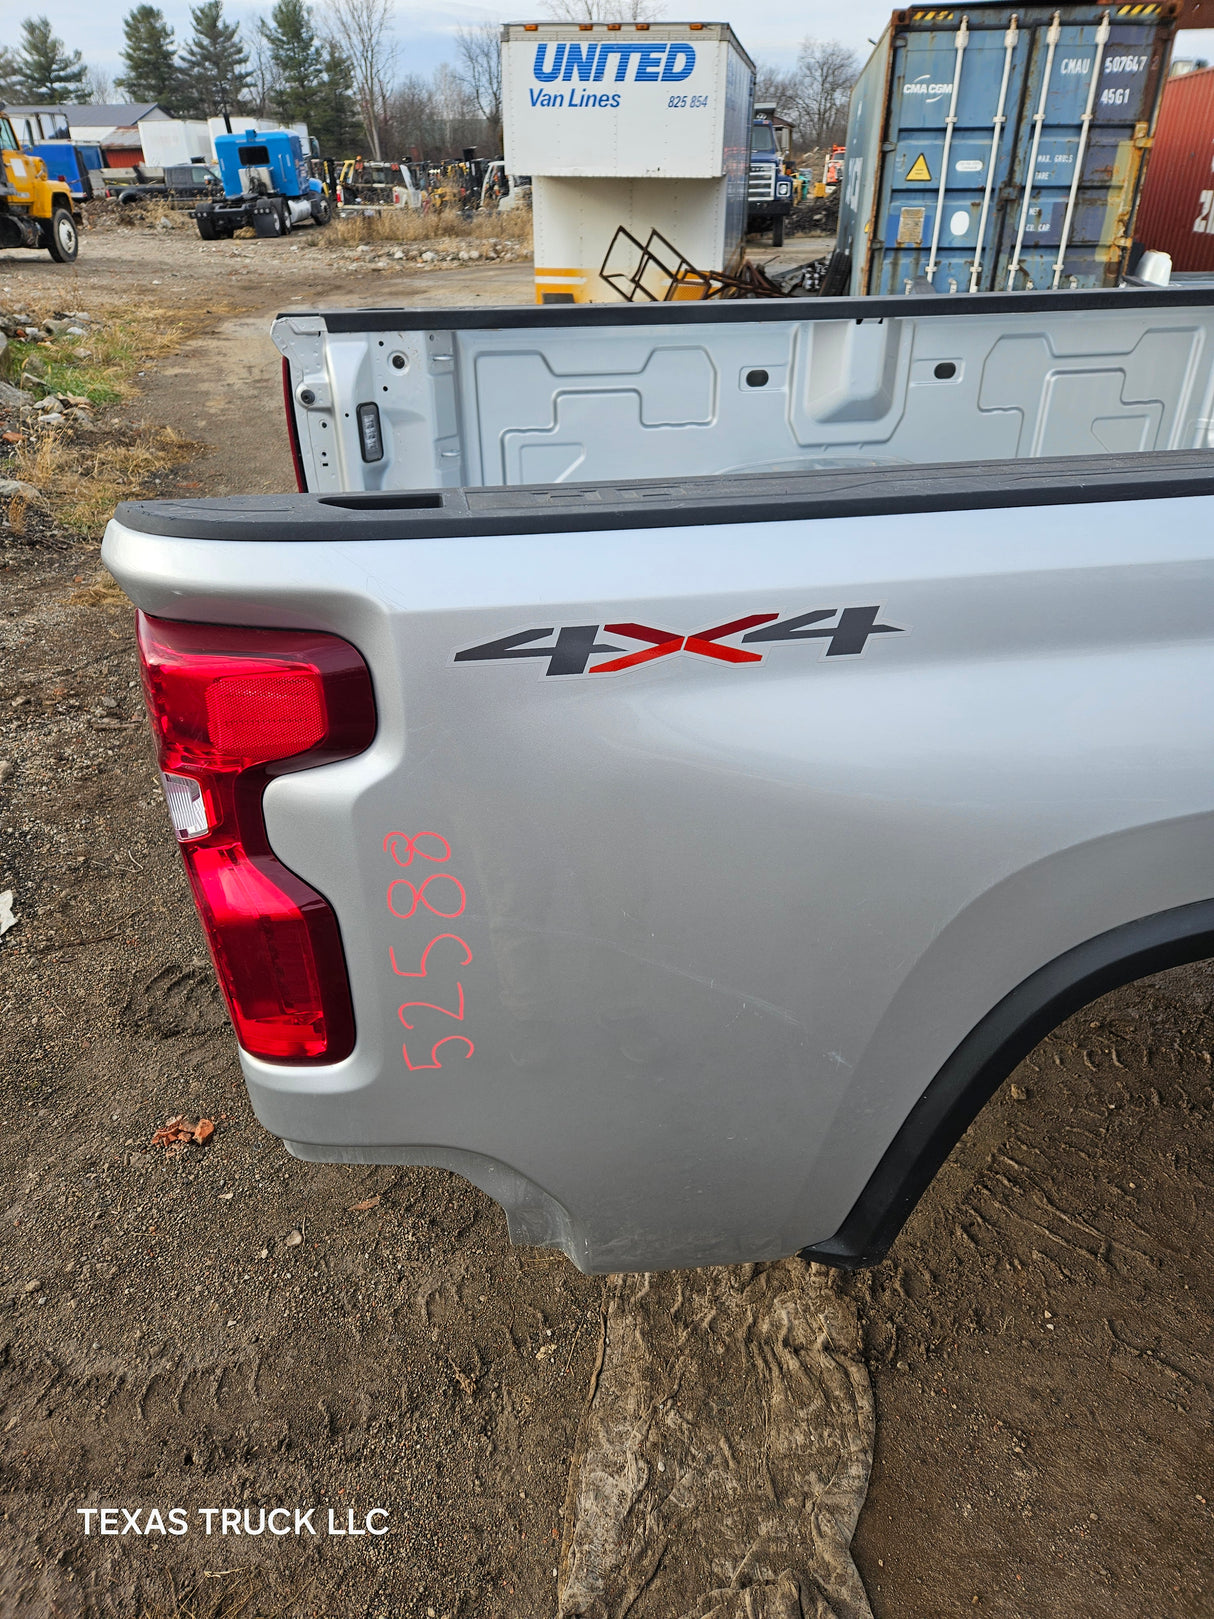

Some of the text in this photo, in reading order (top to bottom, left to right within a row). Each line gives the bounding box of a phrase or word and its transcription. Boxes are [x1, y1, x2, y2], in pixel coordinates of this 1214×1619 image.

[533, 43, 696, 82] UNITED
[1060, 58, 1091, 74] CMAU
[903, 83, 953, 94] CMA CGM
[1100, 88, 1131, 105] 45G1
[529, 88, 621, 108] Van Lines
[668, 95, 709, 108] 825 854
[454, 606, 906, 677] 4X4
[383, 831, 475, 1071] 52588
